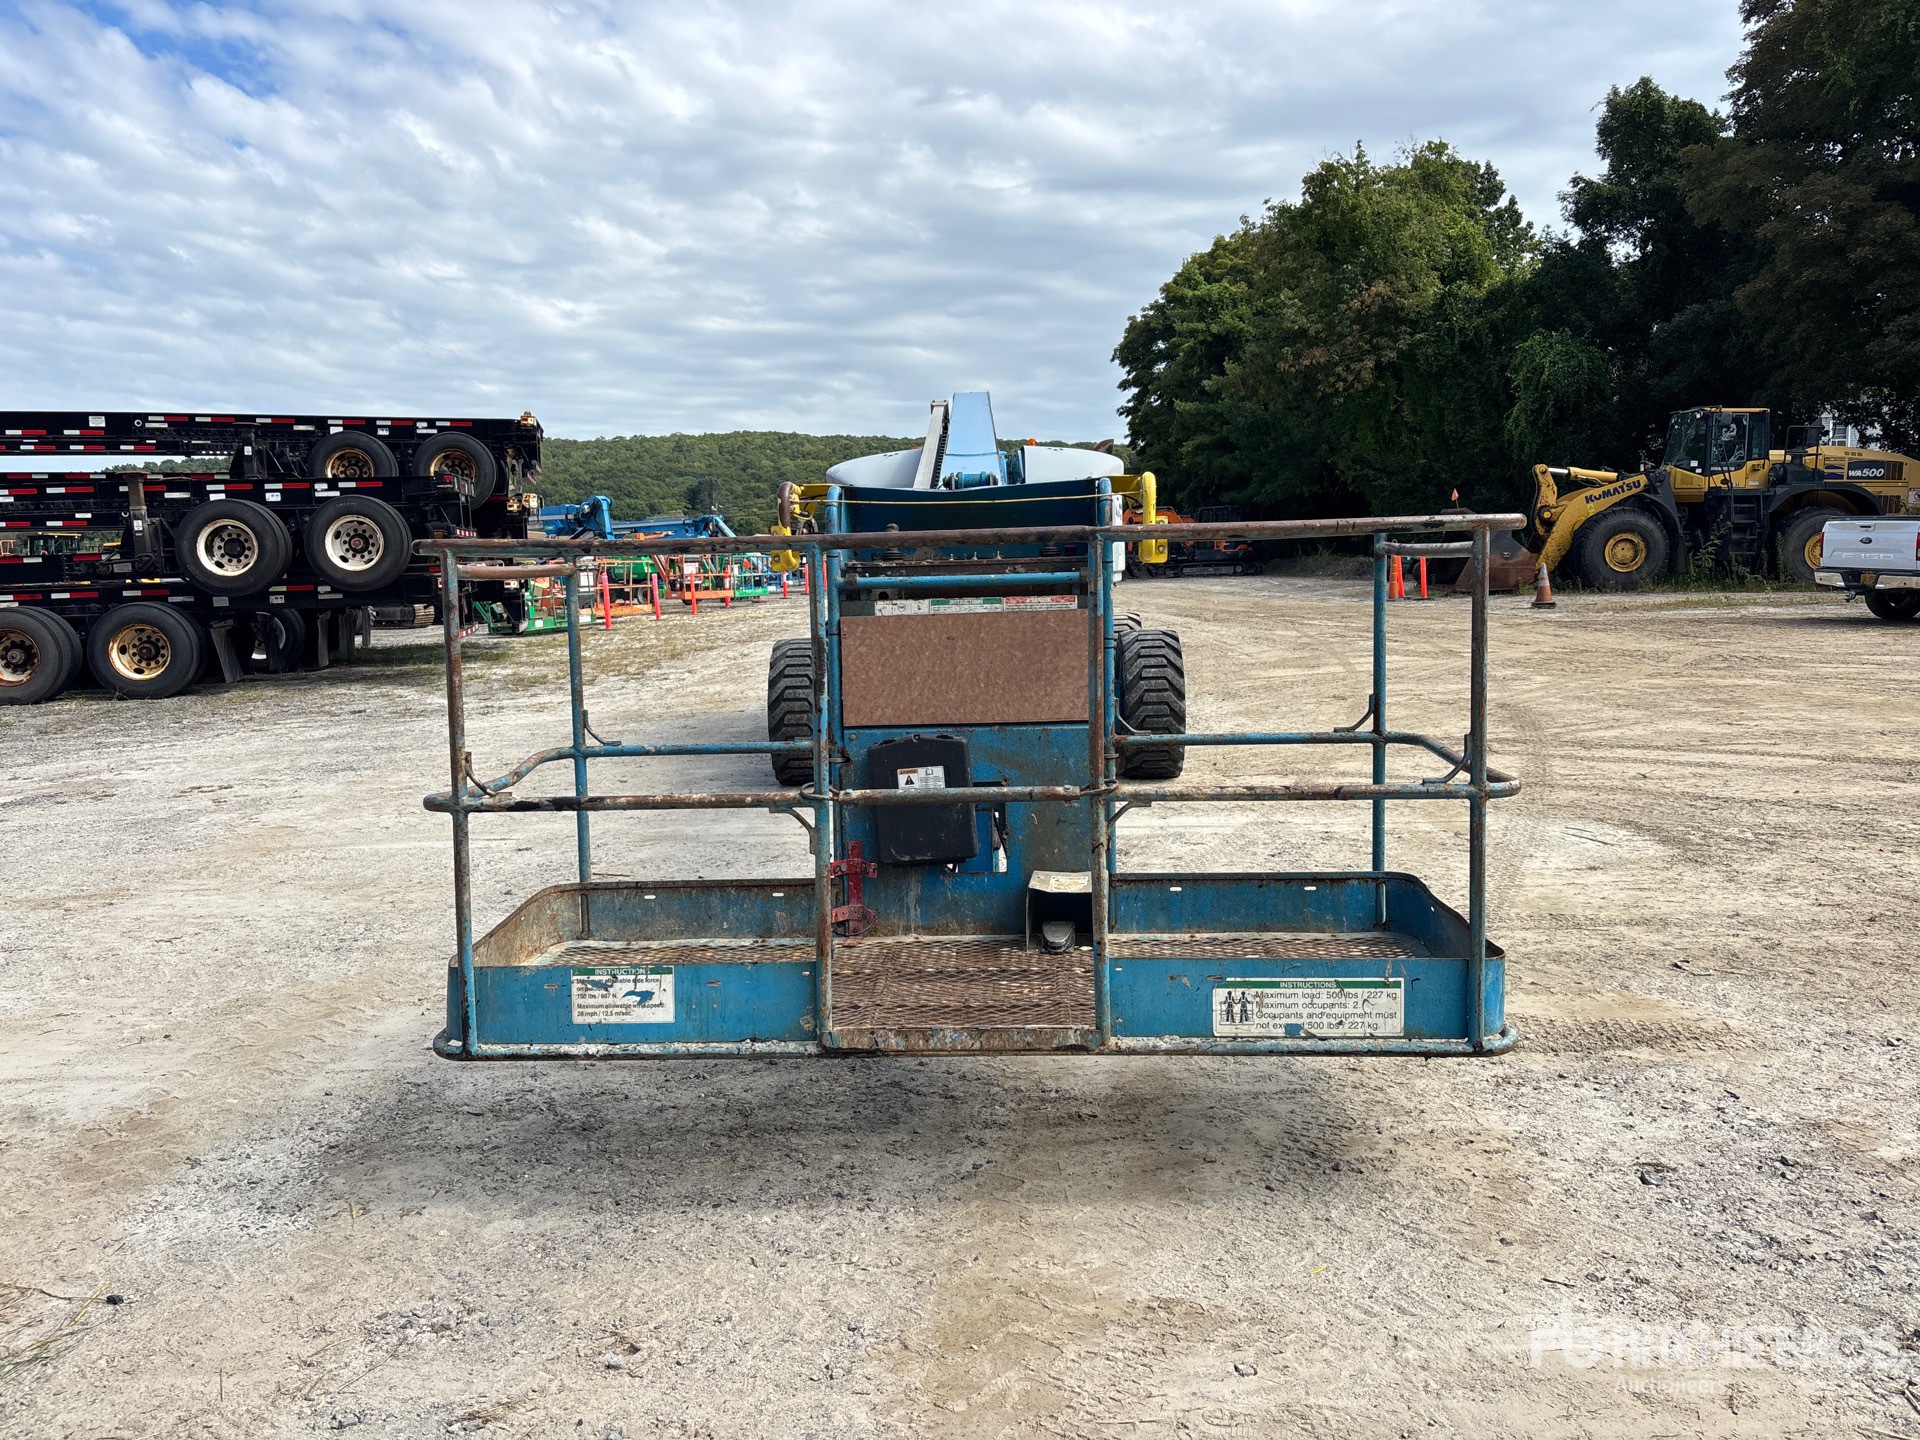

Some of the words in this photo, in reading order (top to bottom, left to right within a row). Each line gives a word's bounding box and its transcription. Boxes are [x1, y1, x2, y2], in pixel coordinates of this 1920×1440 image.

[1848, 467, 1885, 478] WA500
[1585, 479, 1642, 504] KOMATSU
[1279, 981, 1337, 989] INSTRUCTIONS
[1255, 990, 1299, 999] Maximum
[1301, 990, 1324, 999] load:
[1326, 990, 1343, 999] 500
[1345, 990, 1359, 999] lbs
[1367, 990, 1383, 999] 227
[1386, 990, 1400, 1001] kg.
[1255, 1000, 1299, 1009] Maximum
[1301, 1000, 1350, 1011] occupants:
[1352, 1001, 1361, 1009] 2.
[1255, 1010, 1304, 1020] Occupants
[1306, 1010, 1323, 1019] and
[1325, 1011, 1373, 1021] equipment
[1375, 1011, 1398, 1019] must
[1255, 1021, 1270, 1030] not
[1307, 1021, 1325, 1030] 500
[1327, 1021, 1341, 1030] lbs
[1347, 1021, 1365, 1030] 227
[1367, 1021, 1381, 1031] kg.
